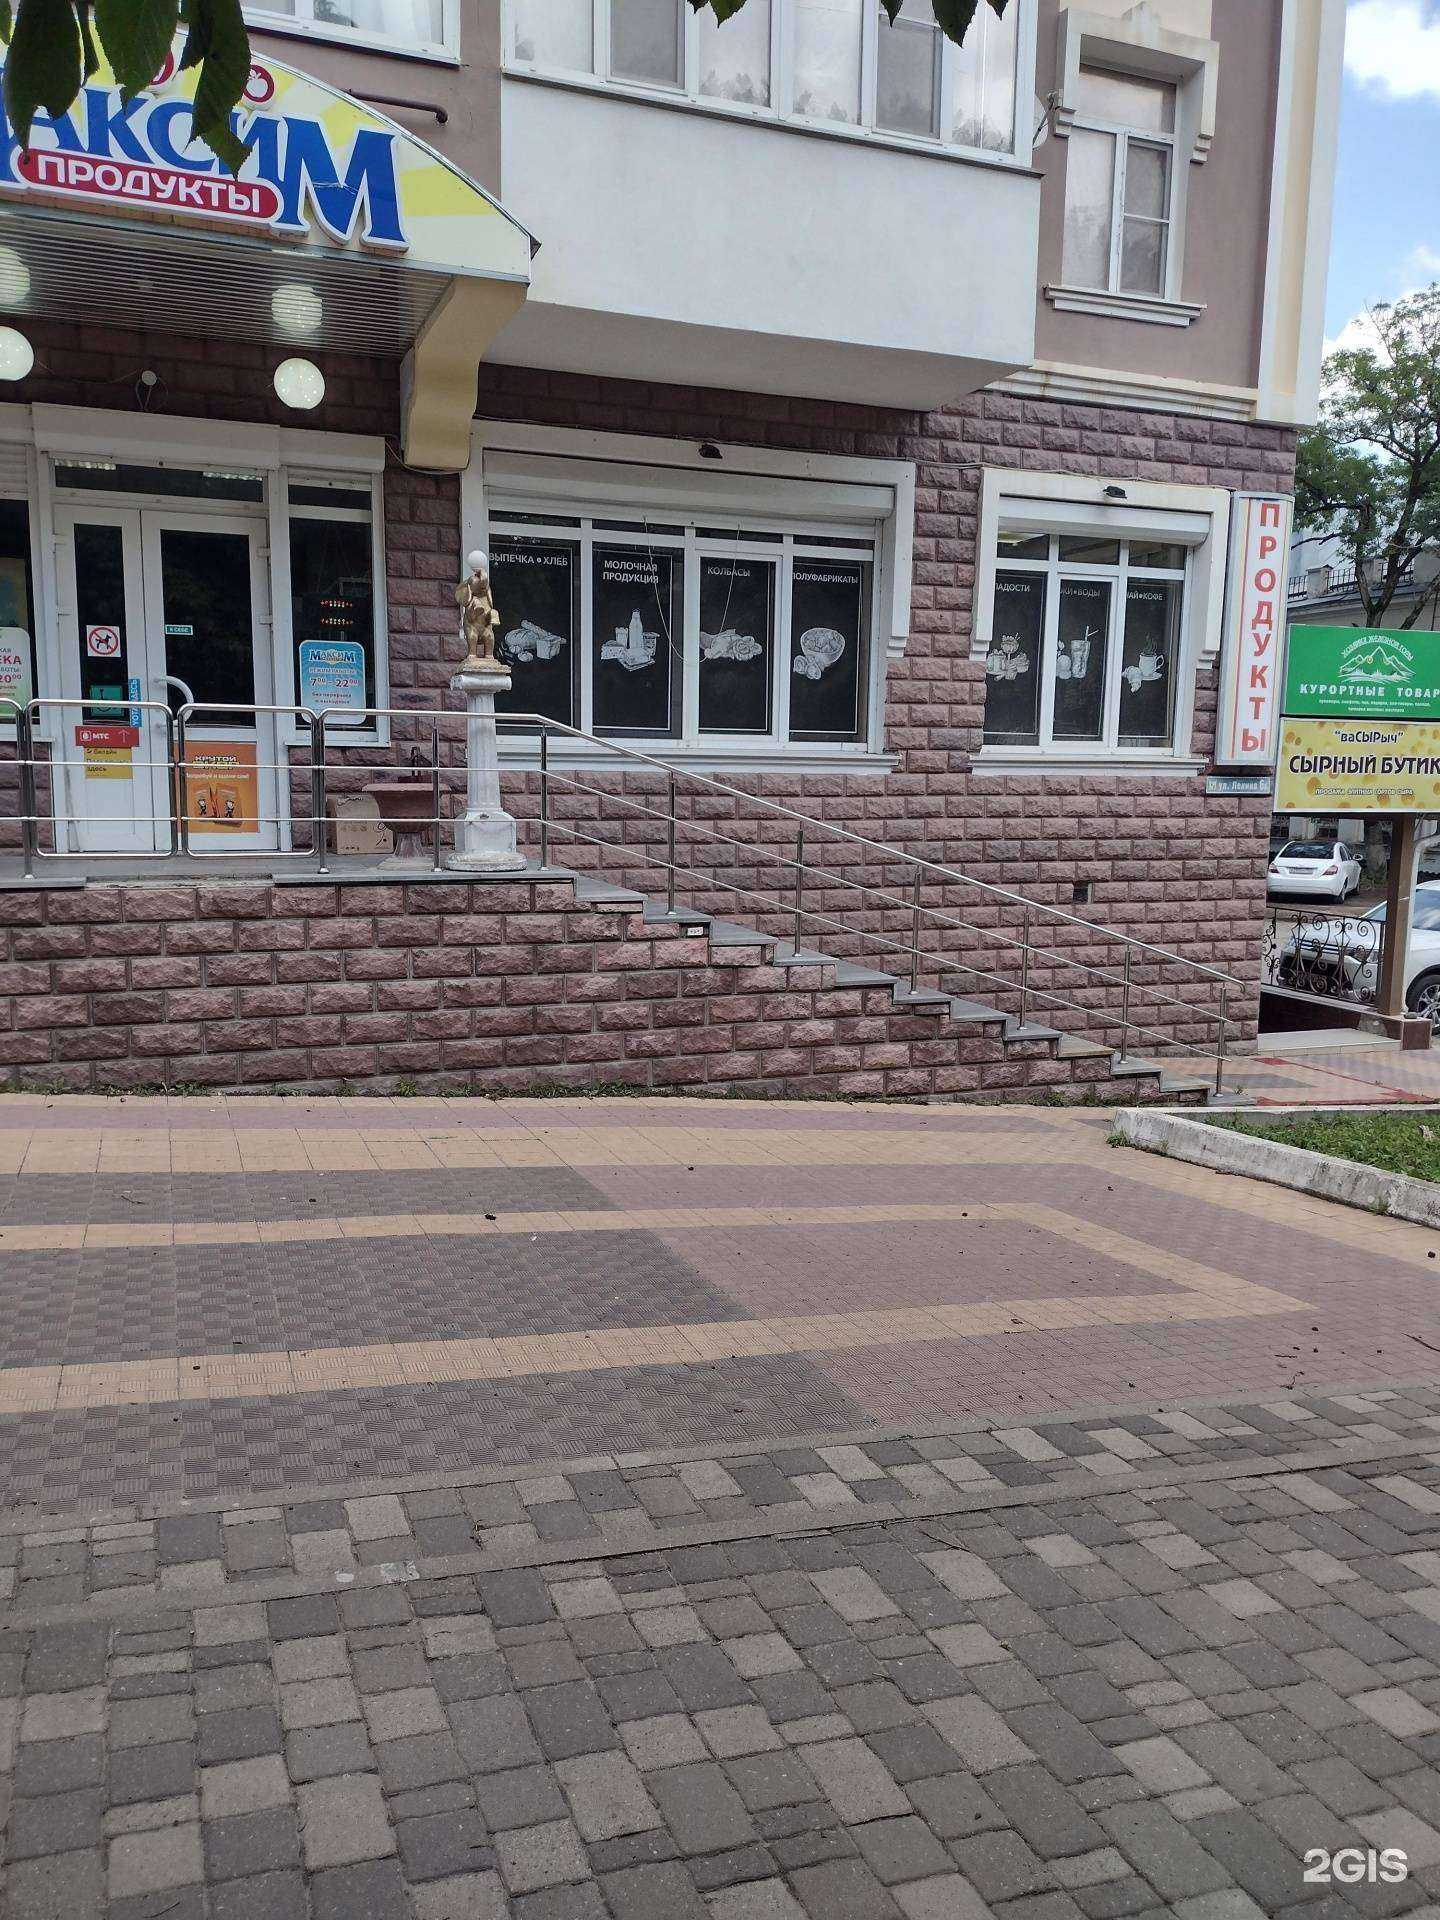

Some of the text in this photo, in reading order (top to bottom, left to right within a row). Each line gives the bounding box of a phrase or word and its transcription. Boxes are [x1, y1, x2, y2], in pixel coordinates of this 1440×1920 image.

[37, 155, 262, 214] ПРОДУКТЫ
[488, 552, 568, 567] ВЫПЕЧКА ХЛЕБ
[604, 560, 658, 572] МОЛОЧНАЯ
[602, 571, 659, 584] ПРОДУКЦИЯ
[707, 566, 751, 577] КОЛБАСЫ
[1143, 592, 1164, 601] КОФЕ
[1241, 502, 1280, 752] ПРОДУКТЫ
[1300, 684, 1440, 698] КУРОРТНЫЕ ТОВАР
[1289, 755, 1440, 775] СЫРНЫЙ БУТИК
